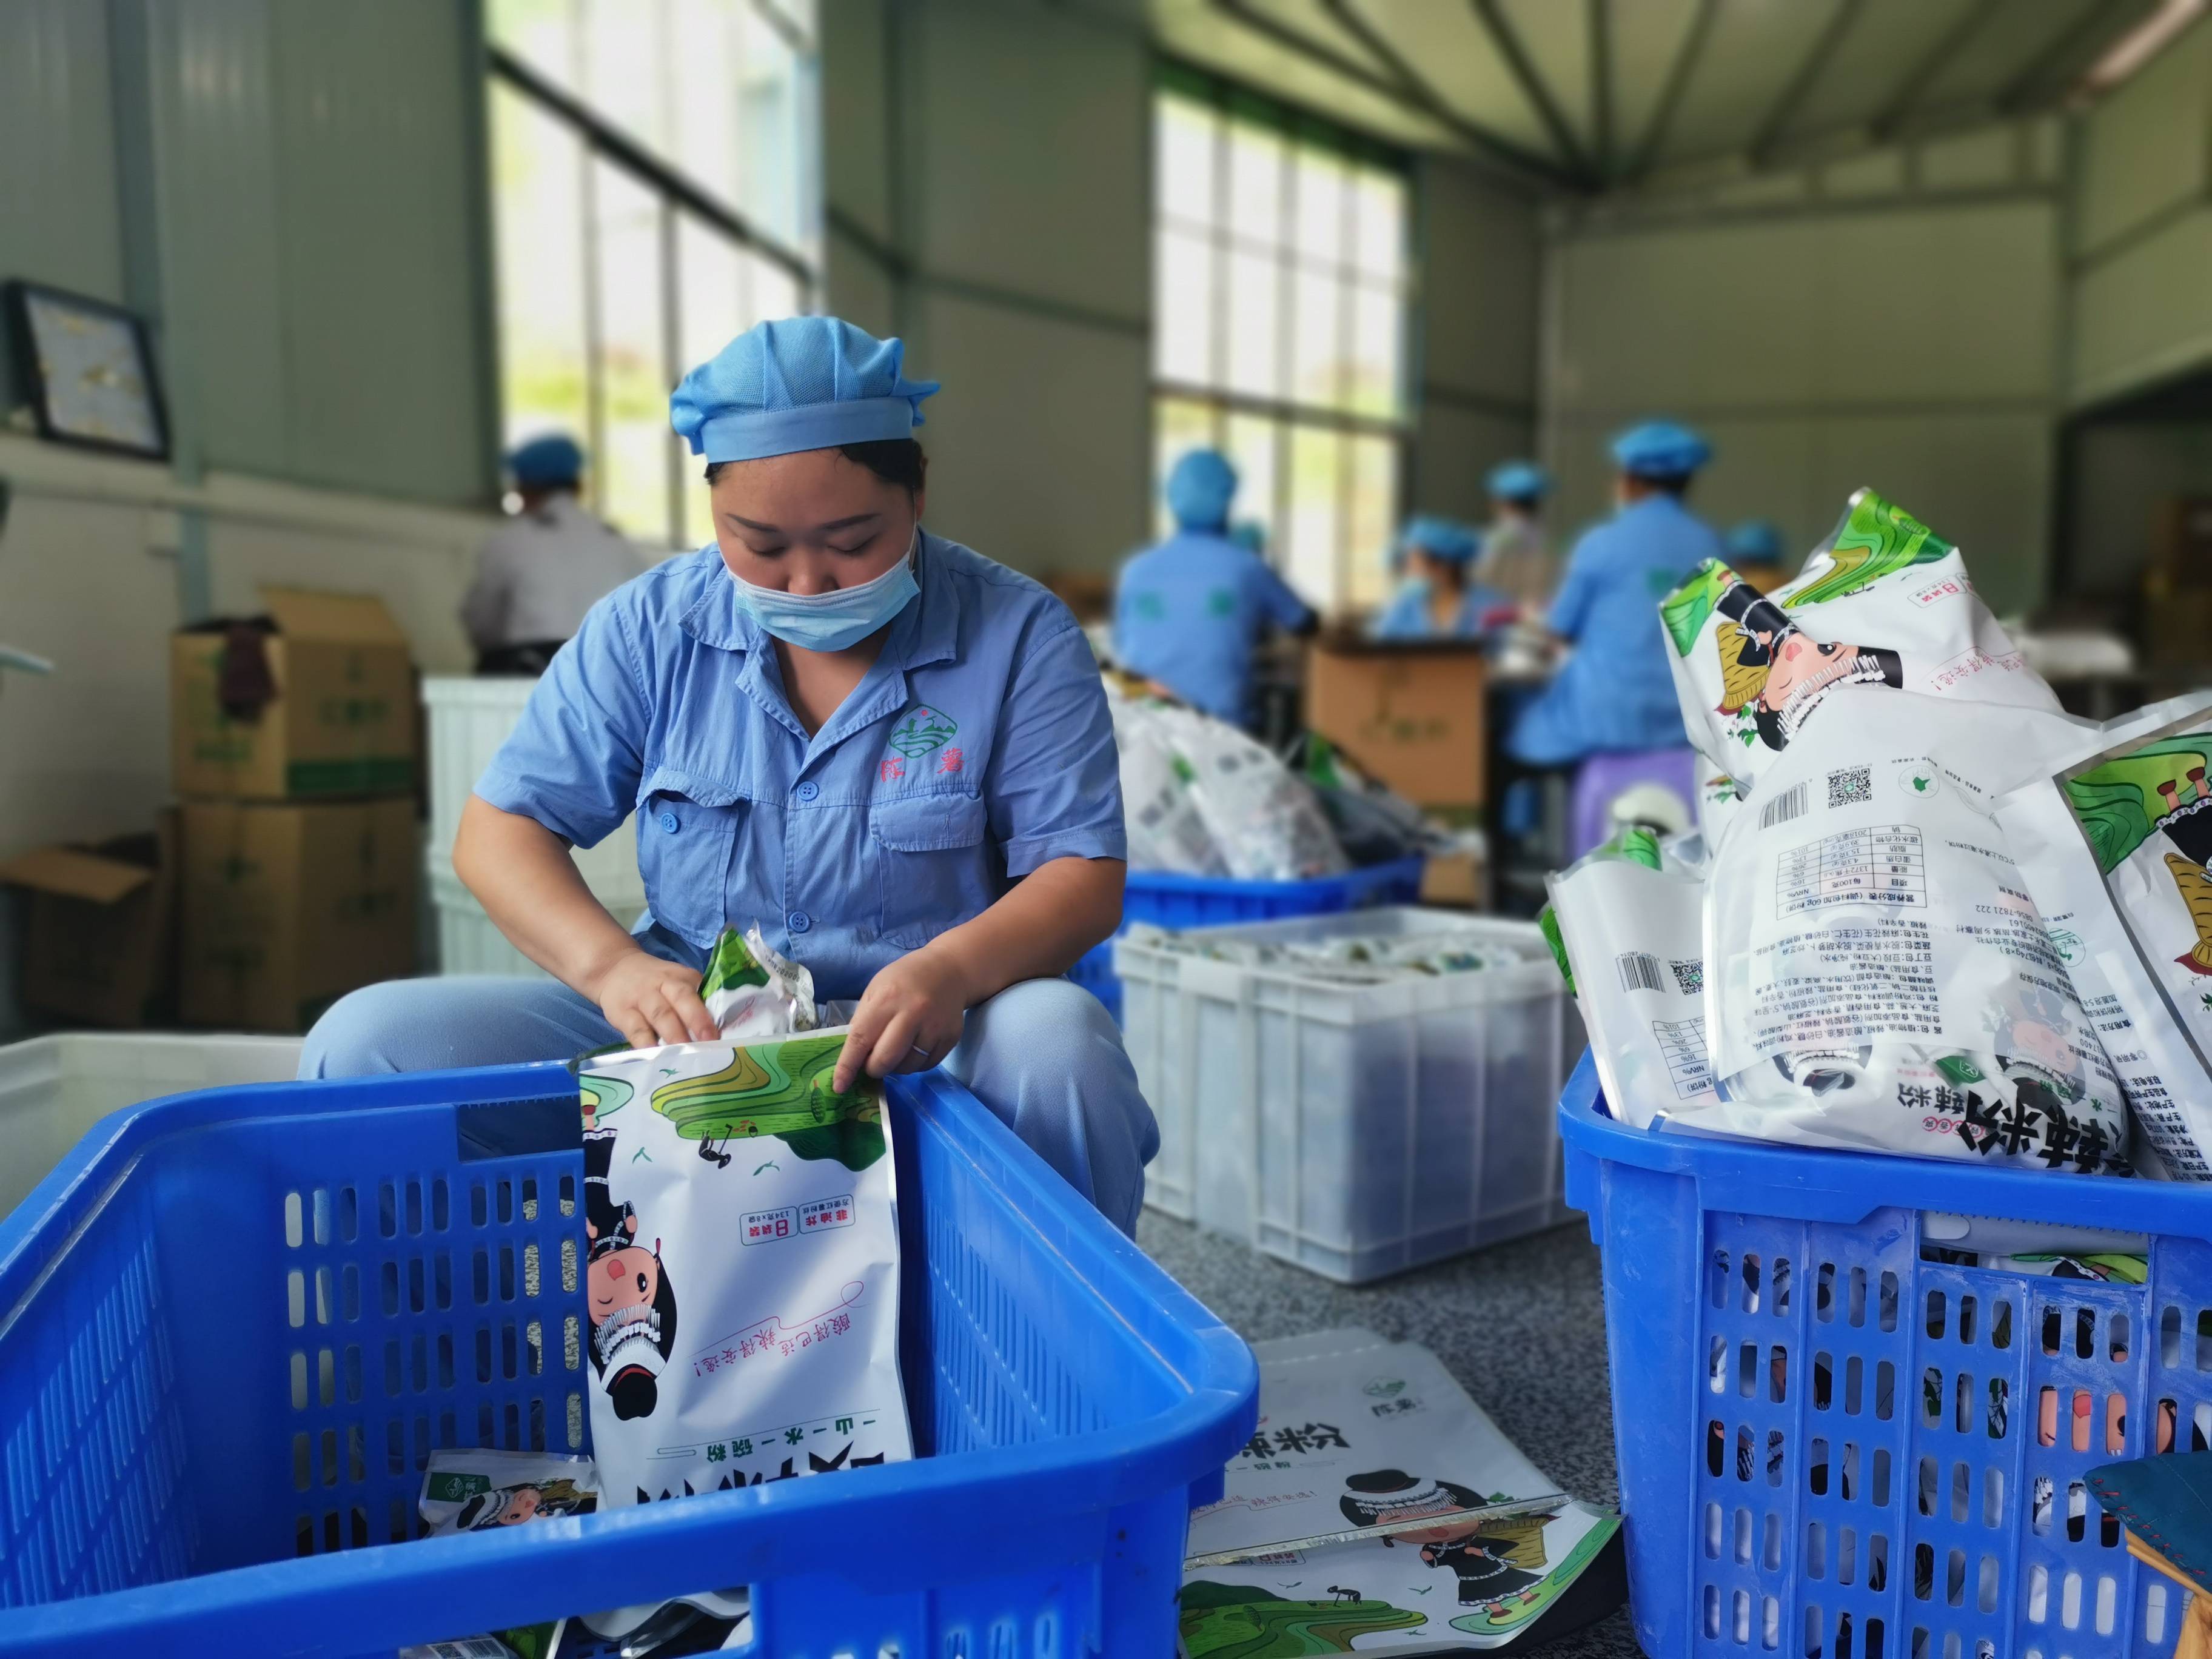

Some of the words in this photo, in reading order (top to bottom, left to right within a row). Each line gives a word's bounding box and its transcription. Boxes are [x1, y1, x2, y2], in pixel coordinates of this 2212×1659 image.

[1831, 878, 1862, 888] 每100克
[1891, 878, 1908, 887] 项目
[1869, 892, 1914, 902] 营养成分表
[1680, 1054, 1697, 1062] 16%
[1682, 1065, 1704, 1075] NRV%
[805, 1210, 848, 1227] 非油炸
[749, 1219, 789, 1238] 8袋装
[777, 1312, 851, 1356] 酸得巴适
